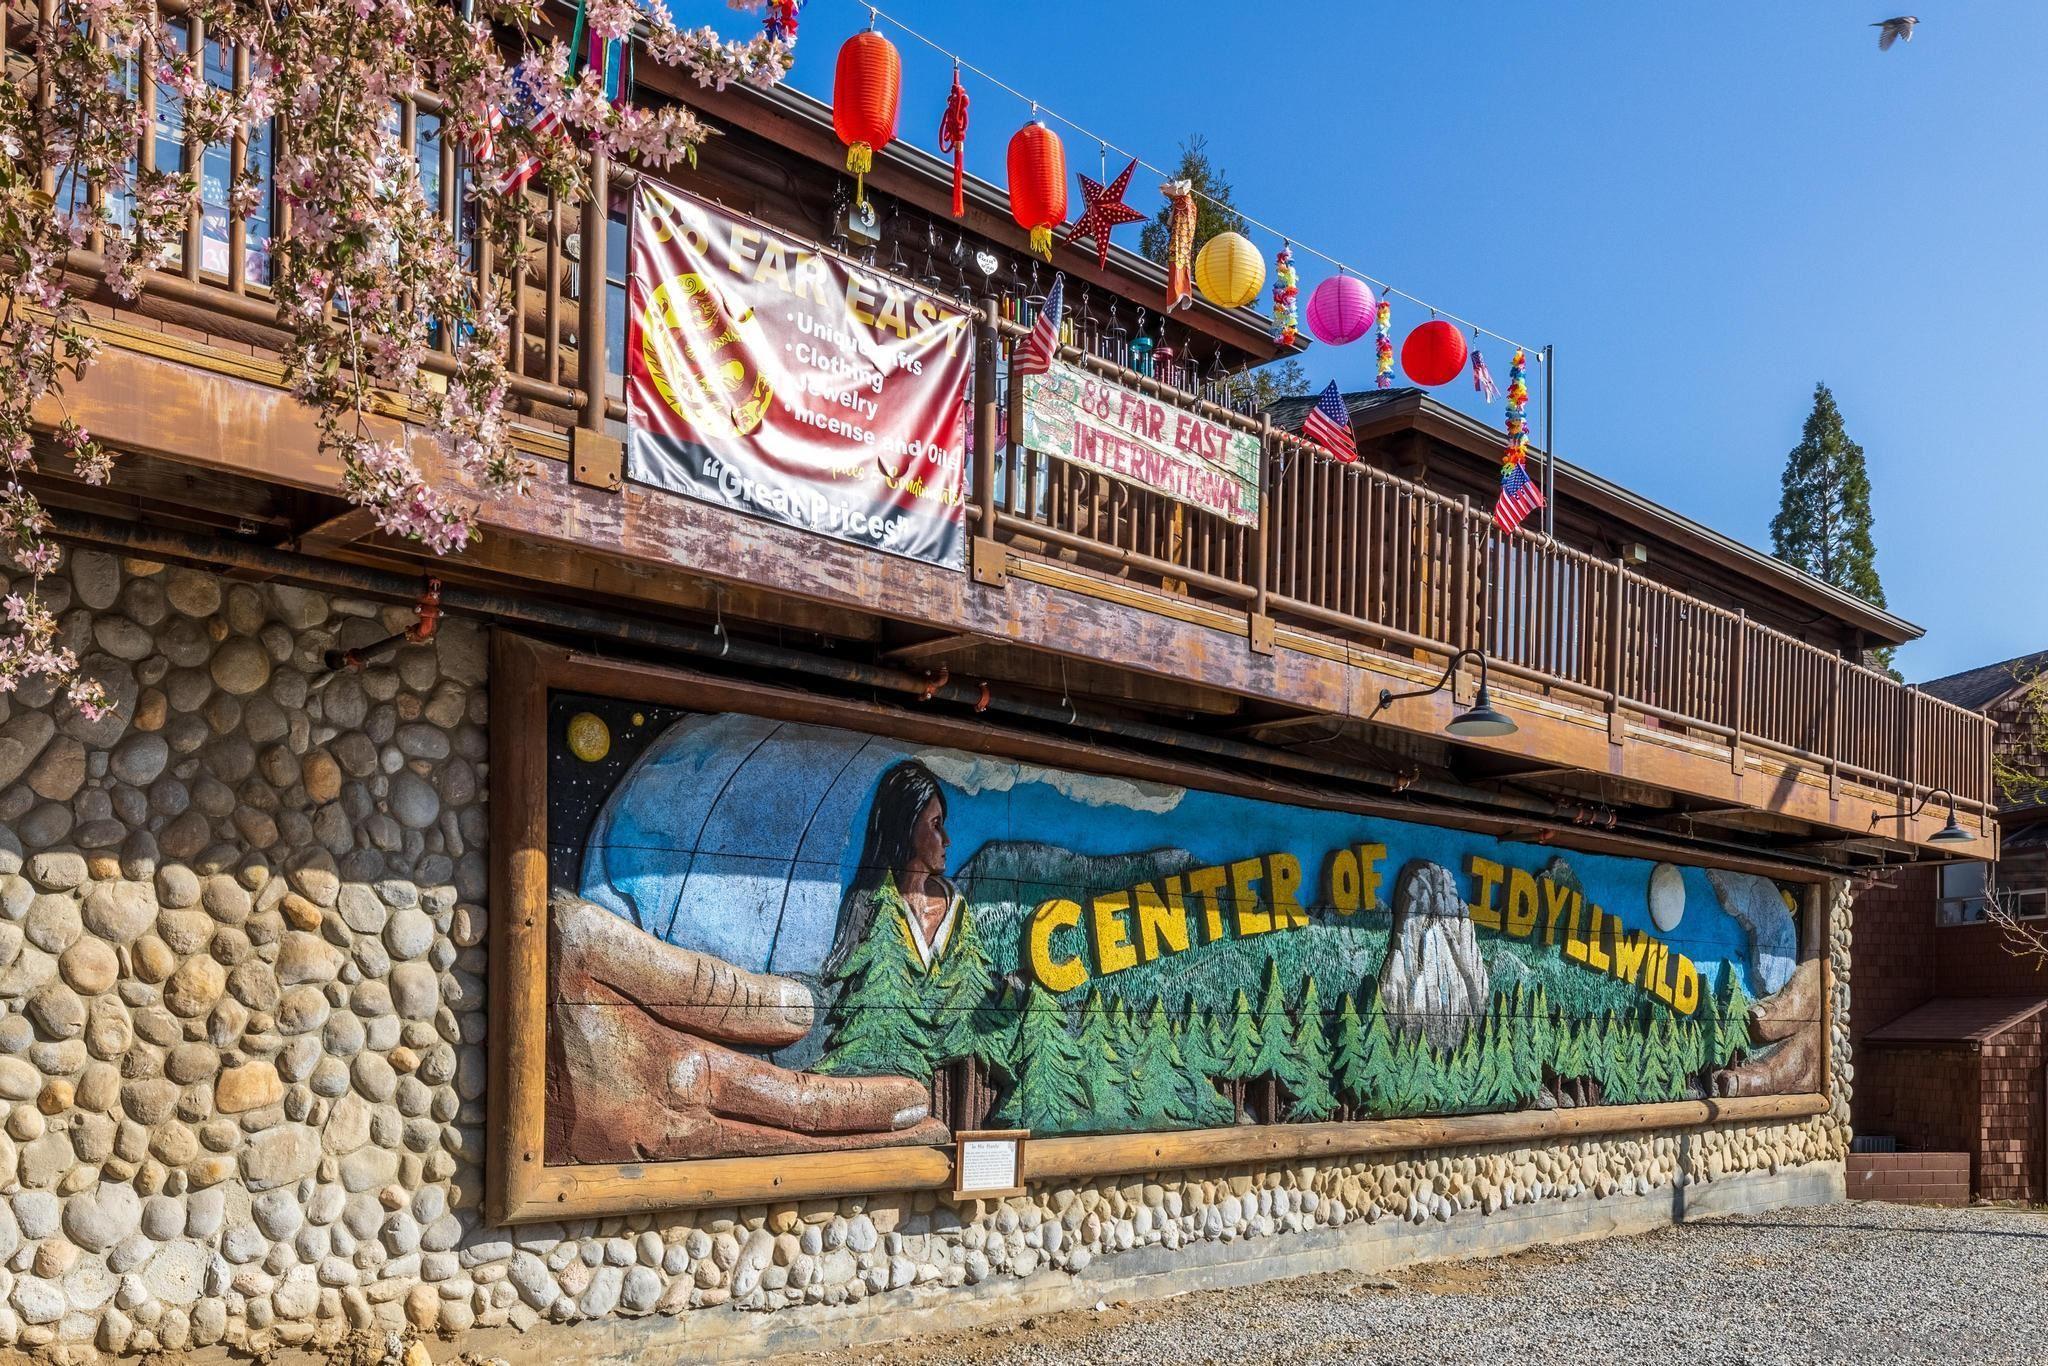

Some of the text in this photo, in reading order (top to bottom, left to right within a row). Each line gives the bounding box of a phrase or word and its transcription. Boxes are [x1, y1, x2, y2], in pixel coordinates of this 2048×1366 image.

[729, 221, 828, 307] FAR
[845, 274, 967, 358] EAST
[795, 343, 884, 394] Clothing
[799, 375, 878, 421] Jewelry
[795, 402, 961, 474] Incense and Oils
[1081, 379, 1233, 464] 88 FAR EAST
[1073, 420, 1245, 516] INTERNATIONAL
[1031, 843, 1700, 1015] CENTER OF IDYLLWILD
